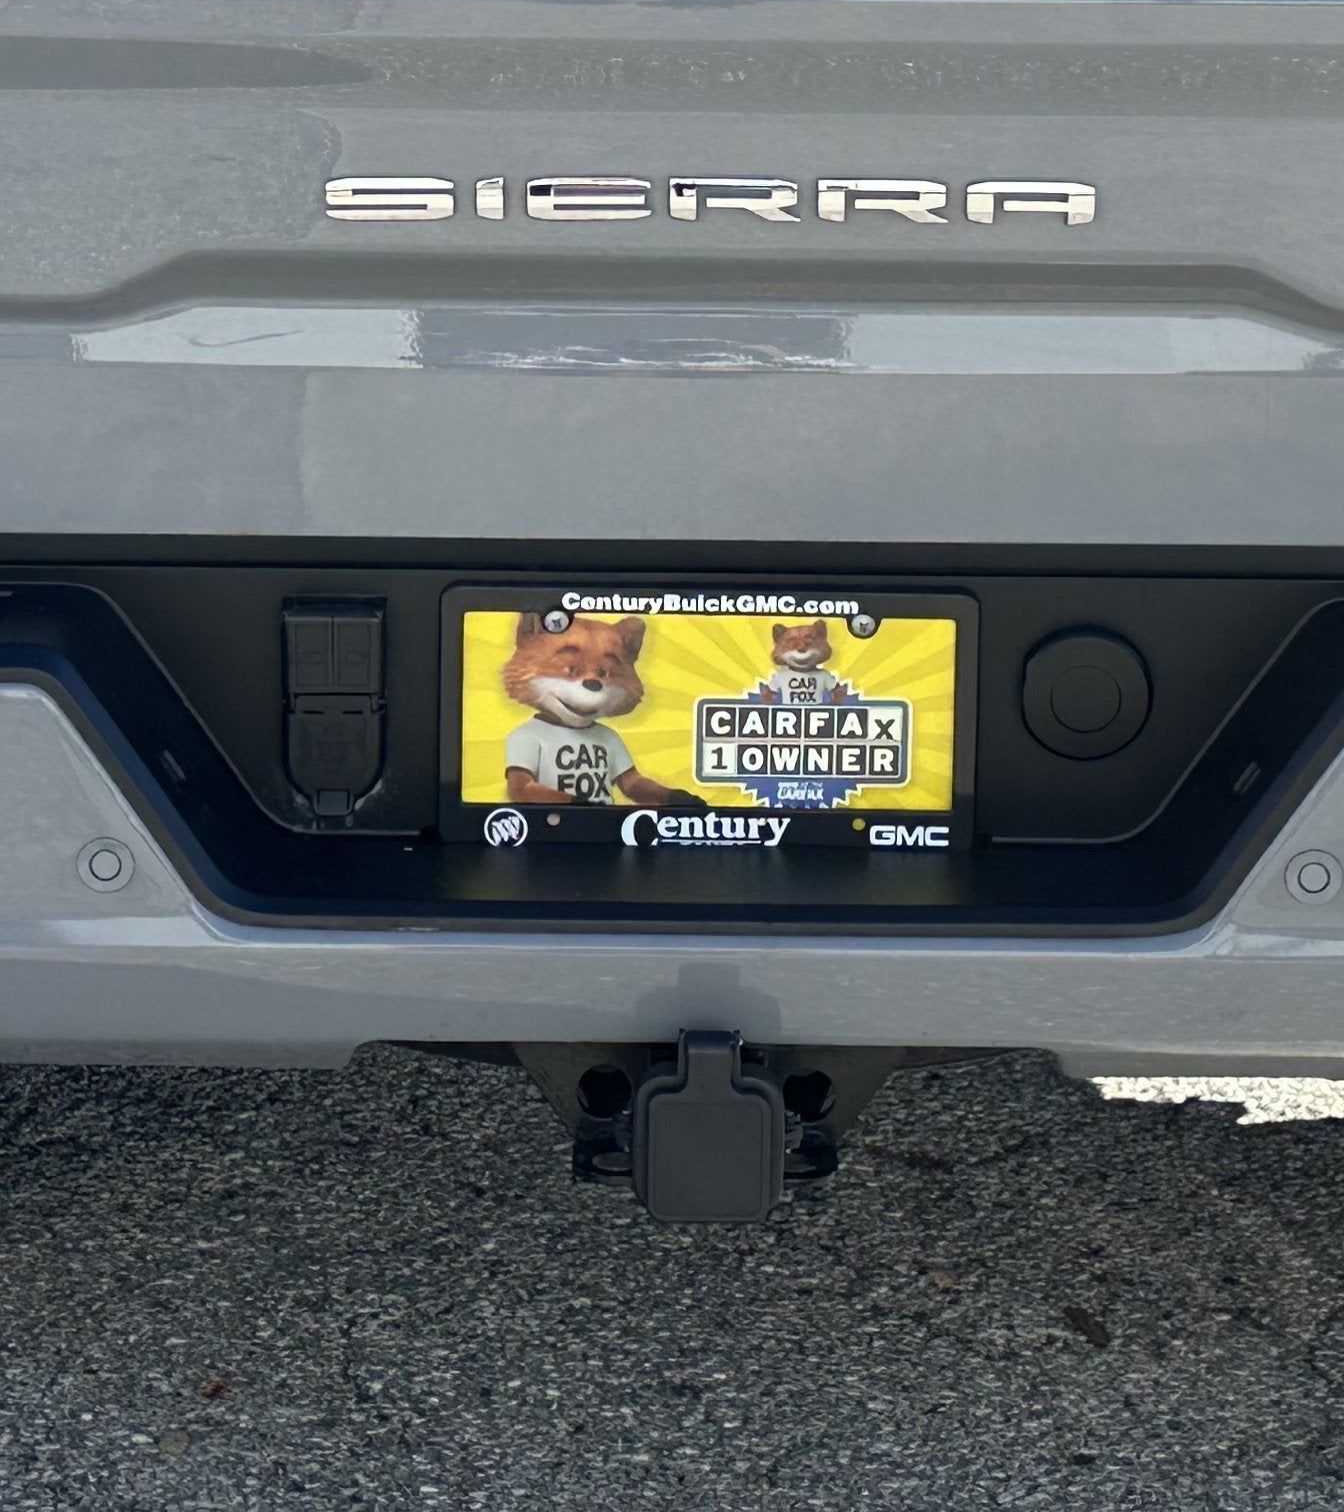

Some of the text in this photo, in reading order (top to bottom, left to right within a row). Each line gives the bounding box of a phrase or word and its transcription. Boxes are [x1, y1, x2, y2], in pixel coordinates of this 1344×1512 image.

[324, 176, 1097, 226] SIERRA
[561, 592, 859, 615] CenturyBuickGMC.com
[788, 676, 817, 690] CAR
[789, 691, 817, 703] FOX
[710, 710, 895, 742] CARFAX
[555, 743, 608, 770] CAR
[557, 772, 610, 799] FOX
[621, 809, 791, 846] Century
[869, 825, 950, 847] GMC
